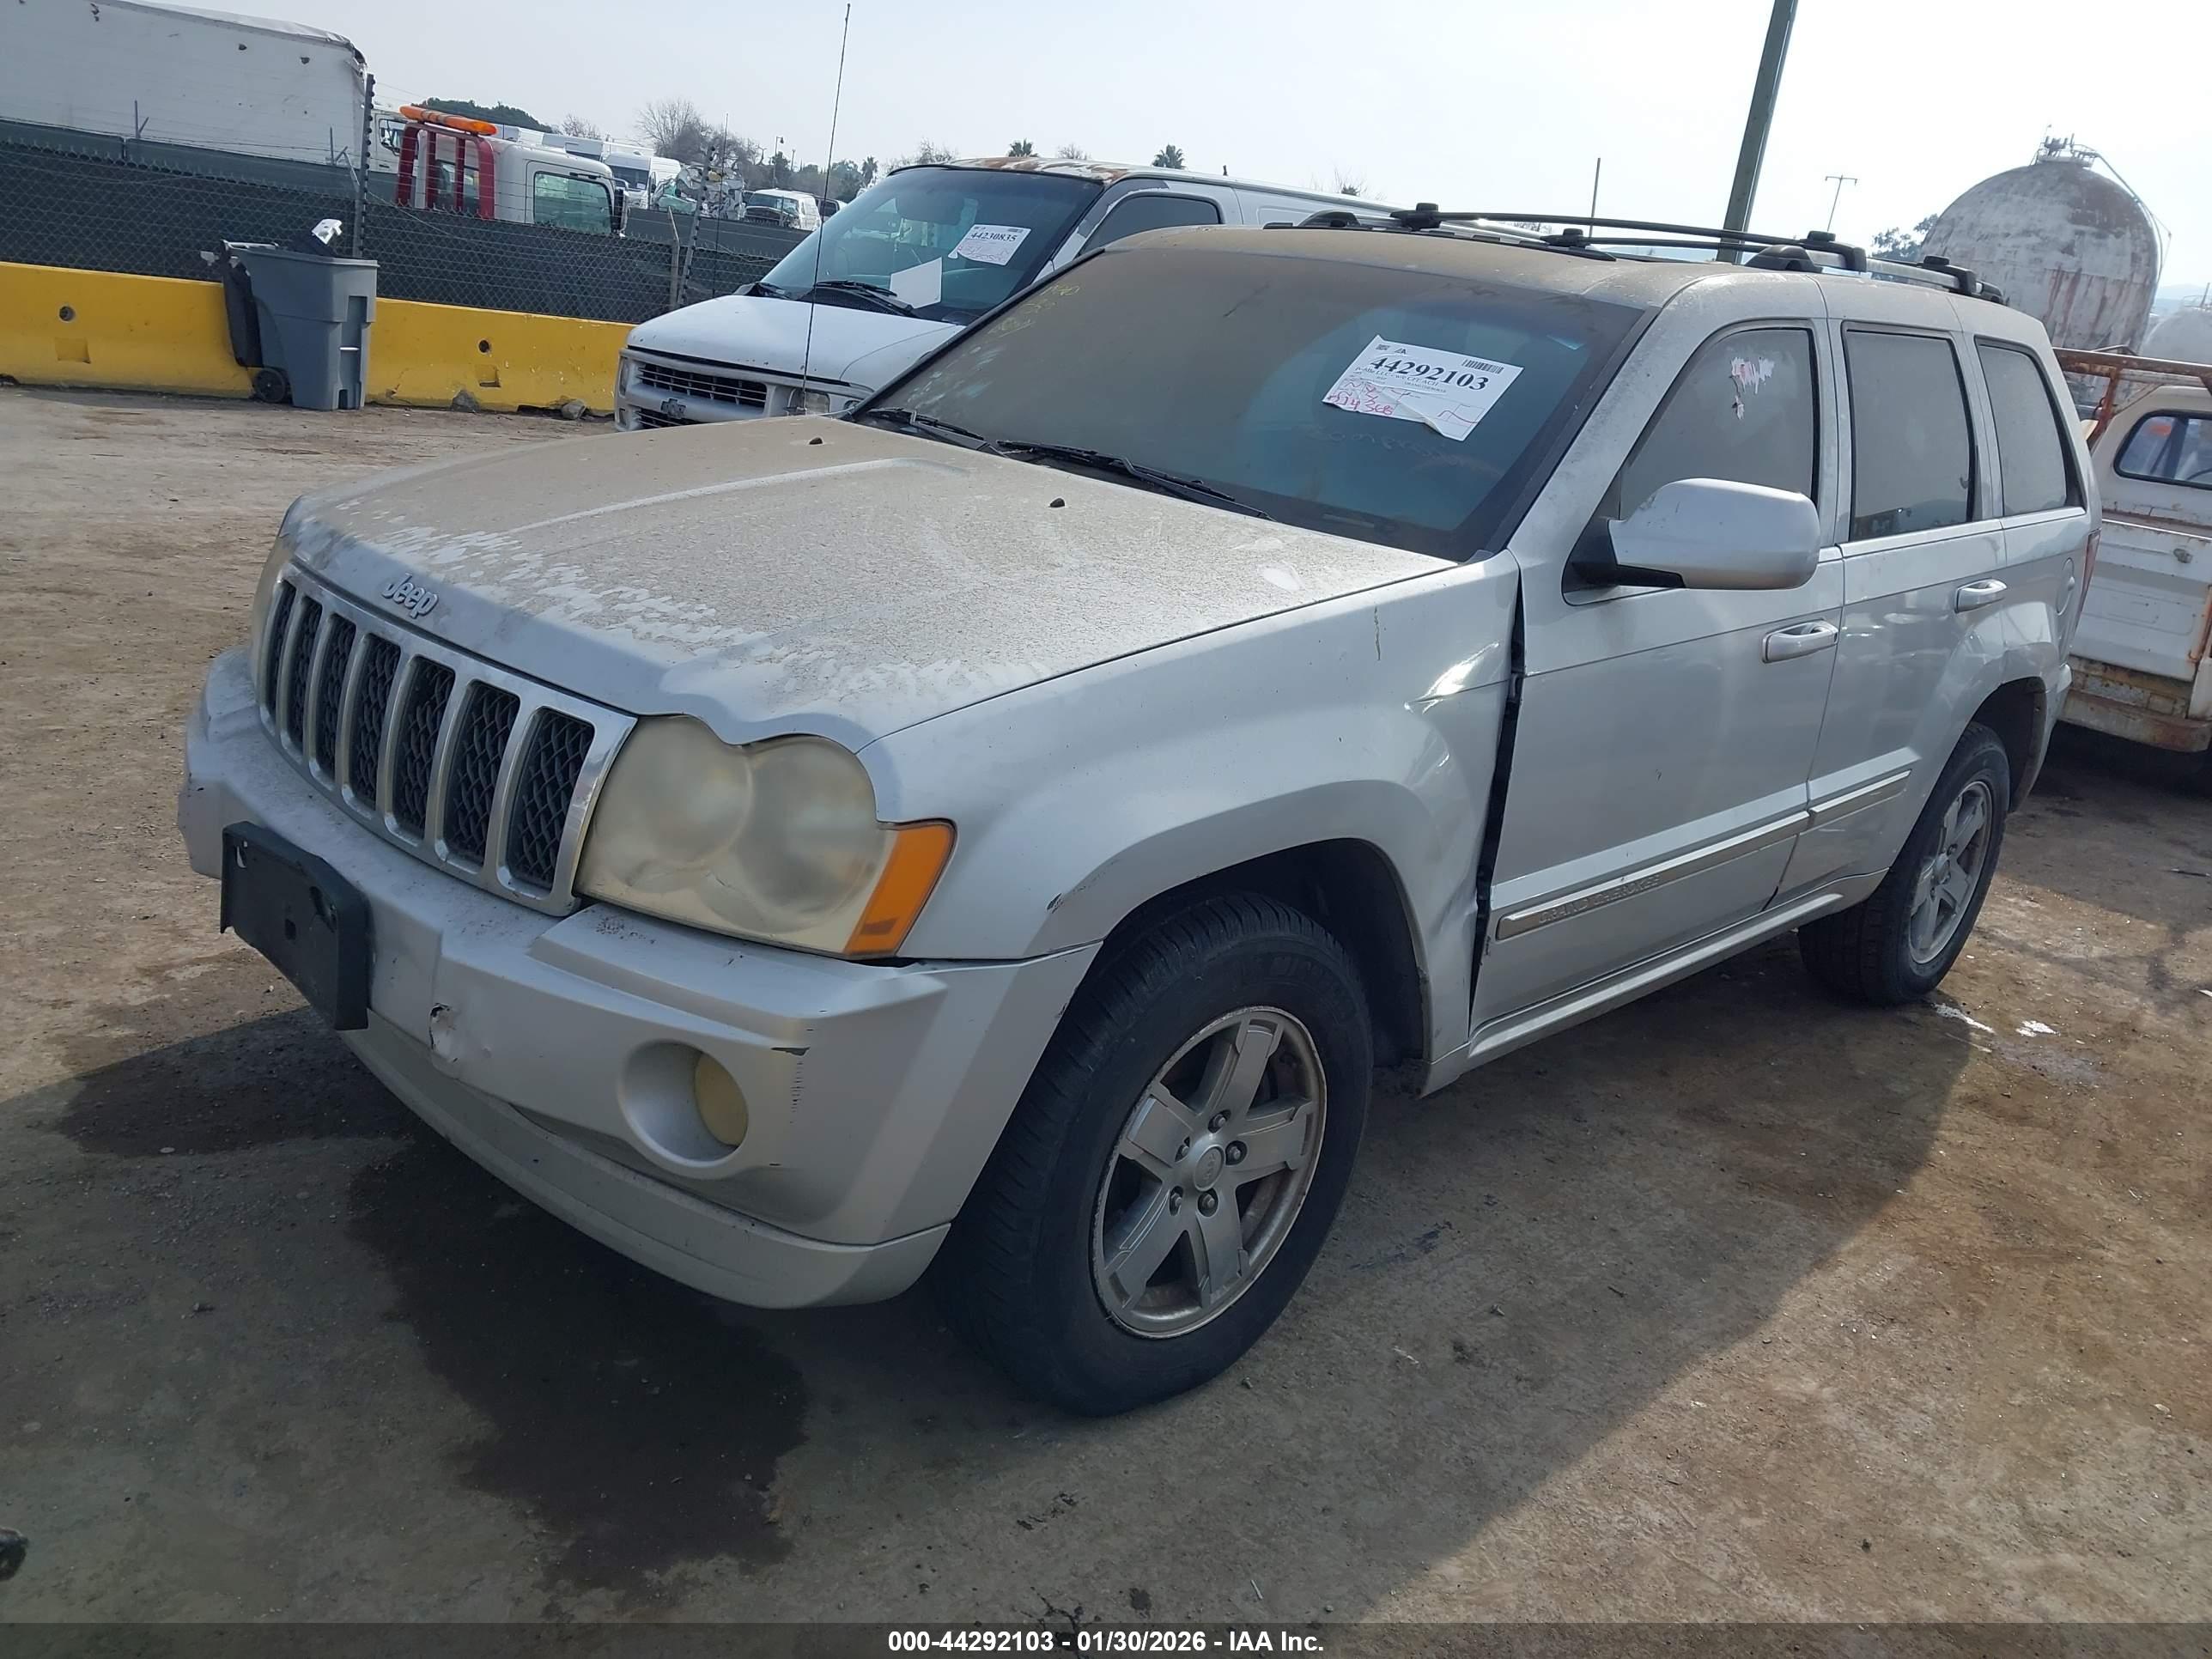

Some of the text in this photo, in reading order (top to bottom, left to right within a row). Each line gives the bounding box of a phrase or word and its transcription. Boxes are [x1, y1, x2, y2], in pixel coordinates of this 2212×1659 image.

[970, 232, 1018, 242] 44230835
[1370, 356, 1489, 391] 44292103
[381, 572, 439, 619] Jeep
